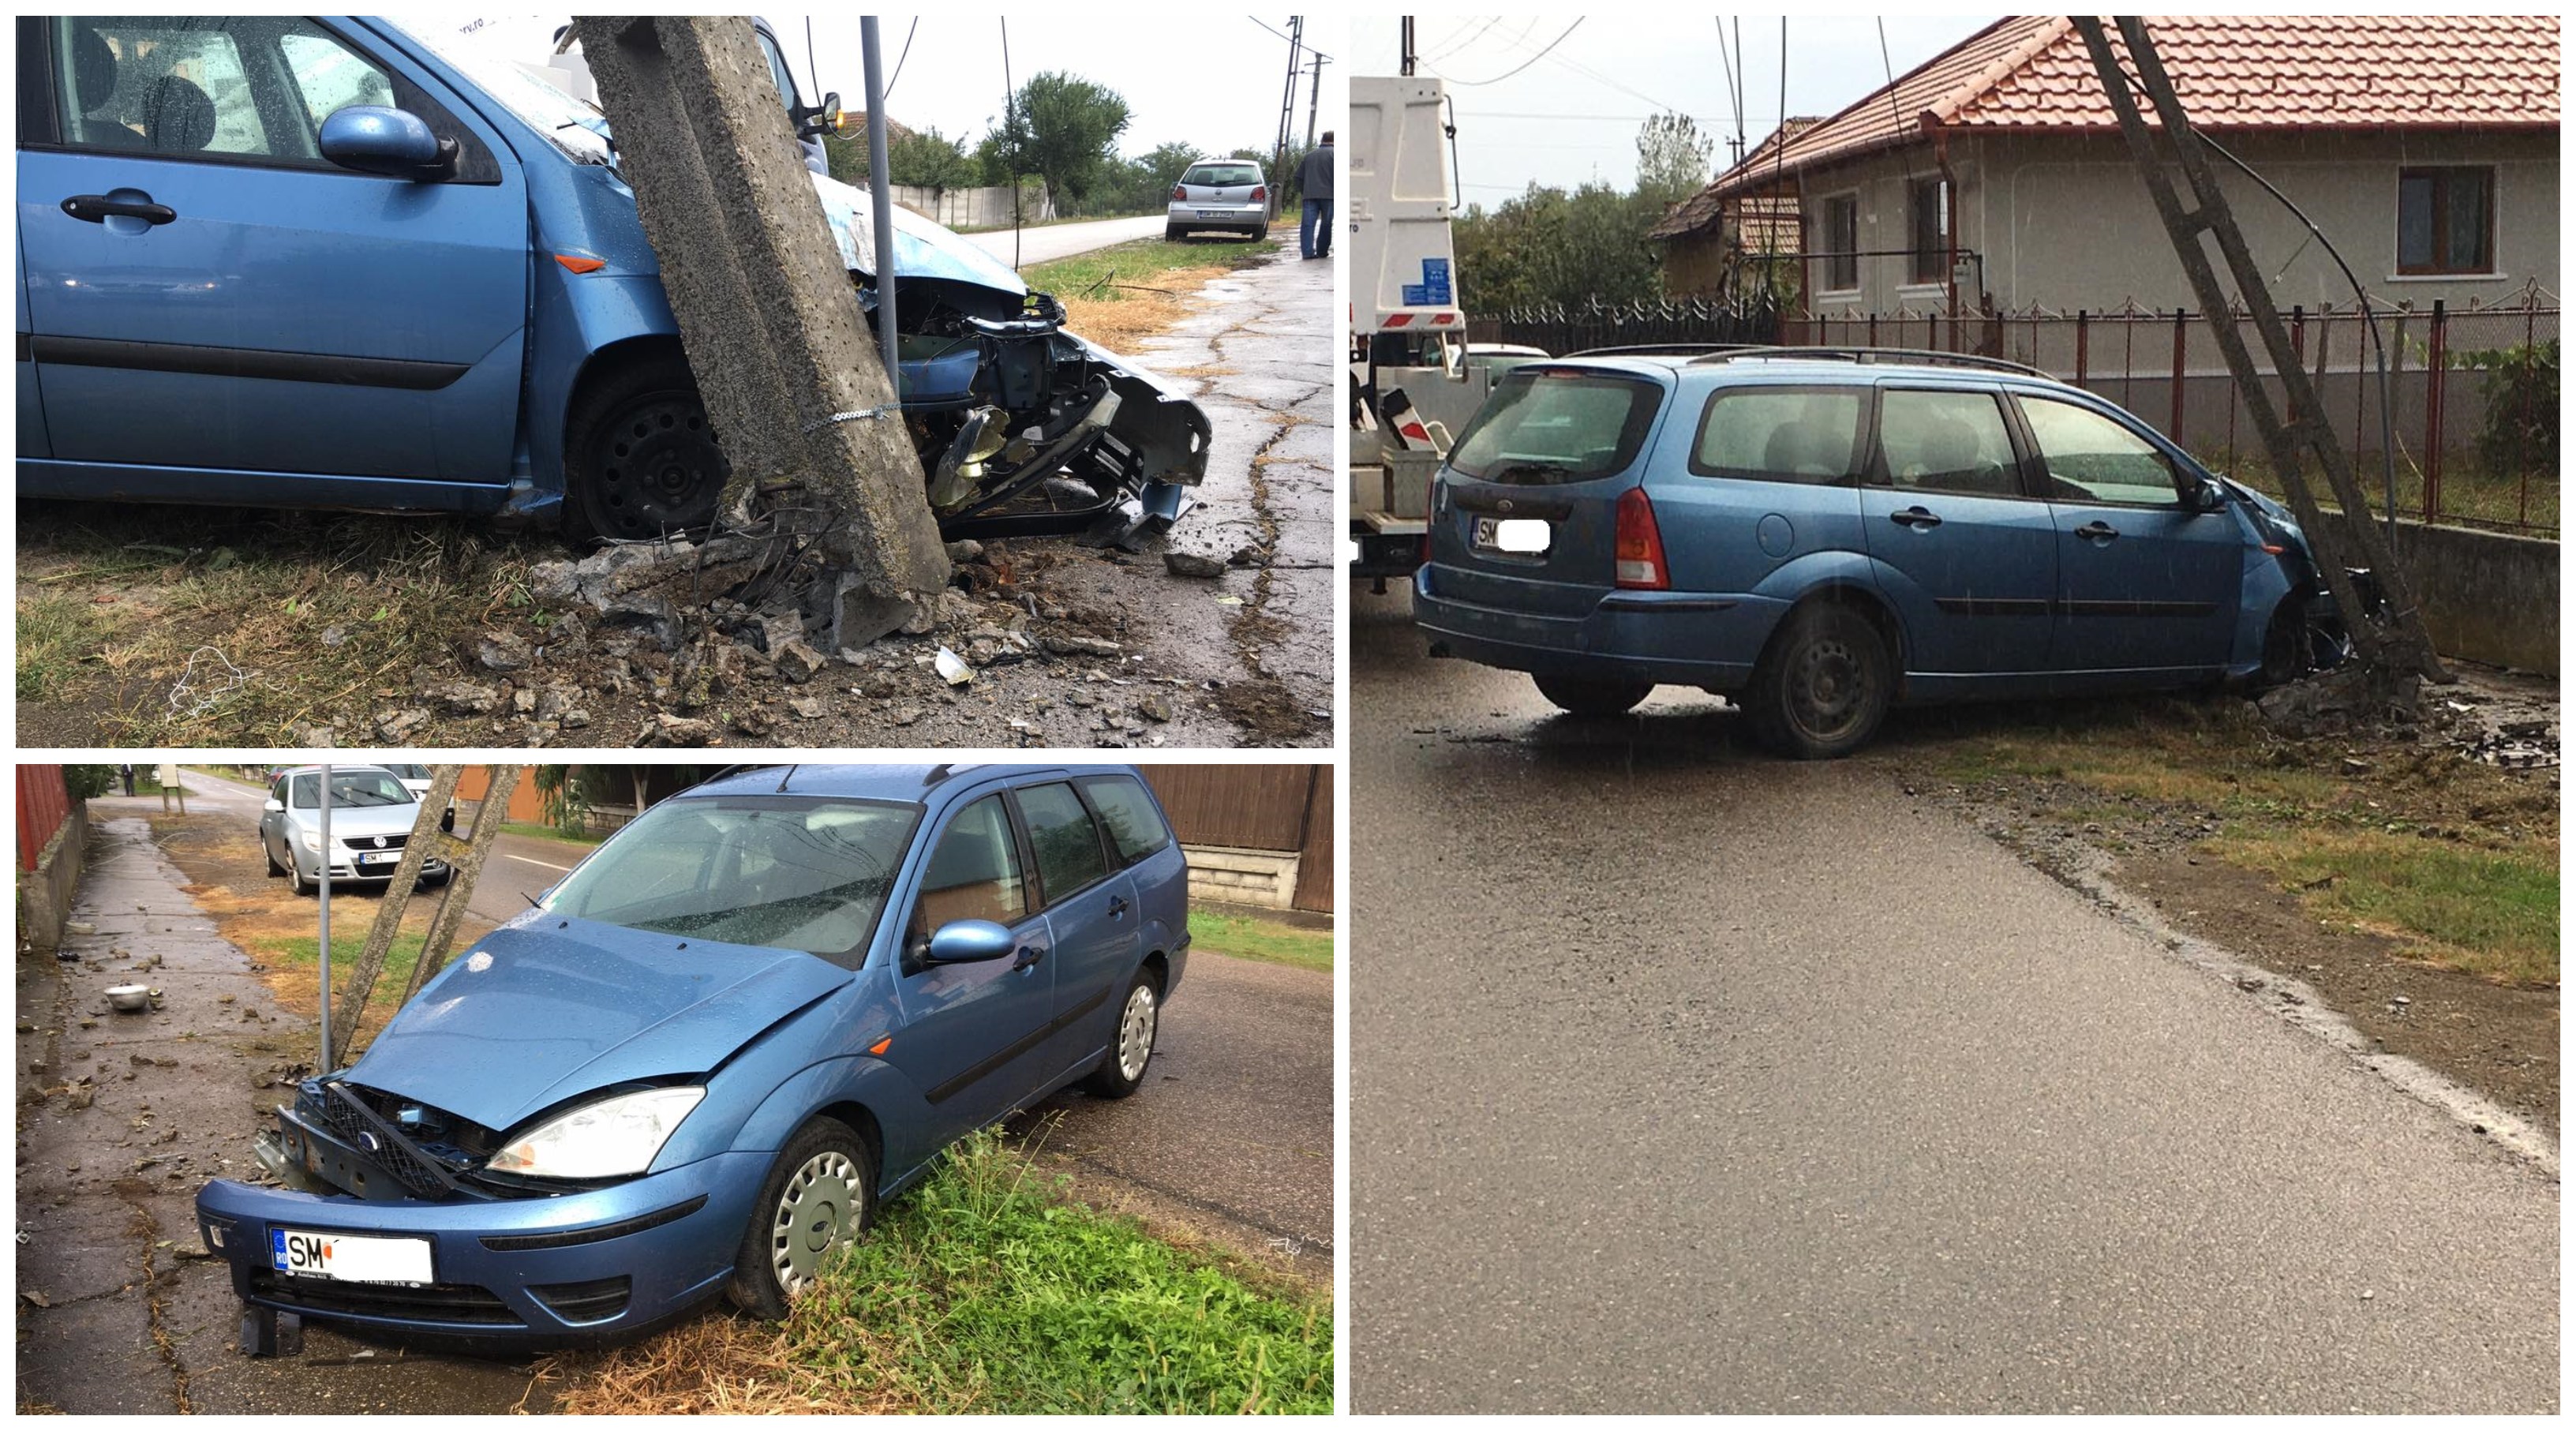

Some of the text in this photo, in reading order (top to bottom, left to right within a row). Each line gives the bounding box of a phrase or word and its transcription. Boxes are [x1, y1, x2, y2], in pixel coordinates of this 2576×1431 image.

[1479, 521, 1497, 543] SM
[275, 1235, 324, 1269] RO SM
